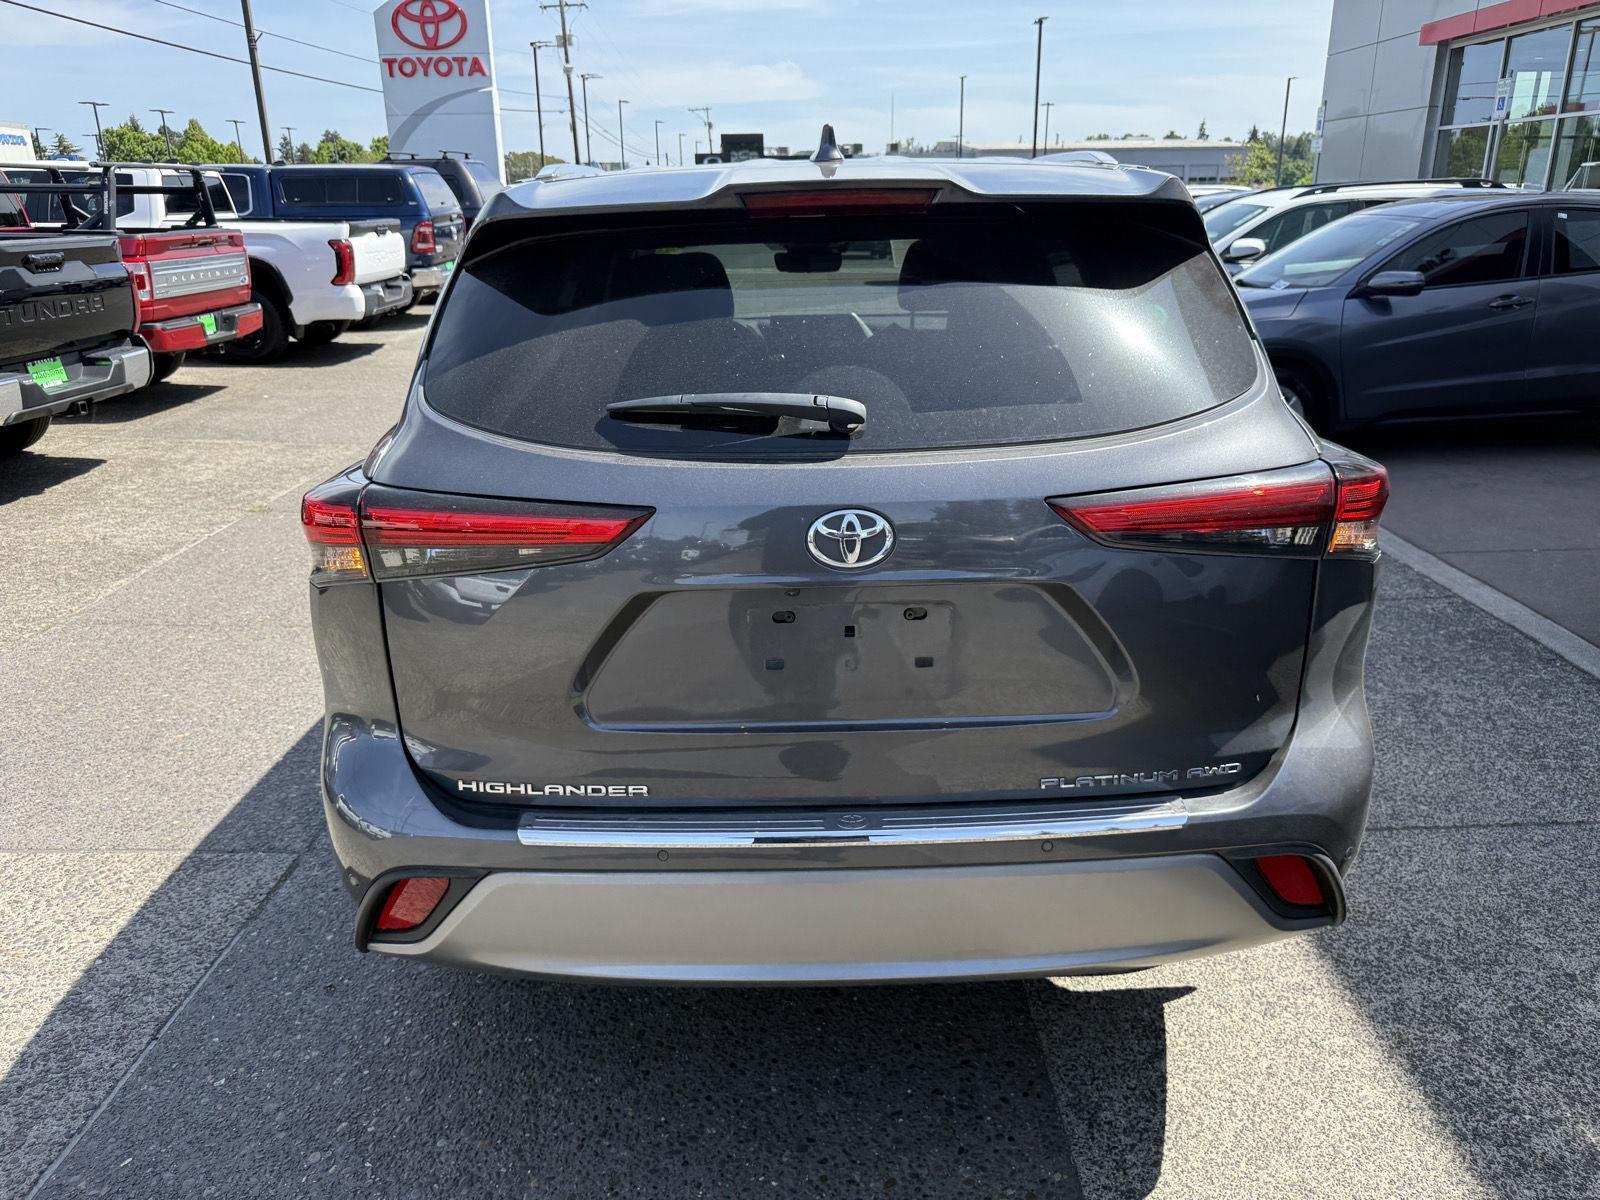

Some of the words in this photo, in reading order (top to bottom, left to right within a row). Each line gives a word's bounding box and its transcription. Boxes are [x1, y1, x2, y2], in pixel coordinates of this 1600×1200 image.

[382, 56, 488, 78] TOYOTA
[172, 268, 238, 282] PLATINUM
[0, 294, 105, 327] TUNDRA
[1040, 769, 1178, 789] PLATINUM
[1186, 761, 1242, 779] AWD
[458, 779, 649, 797] HIGHLANDER
